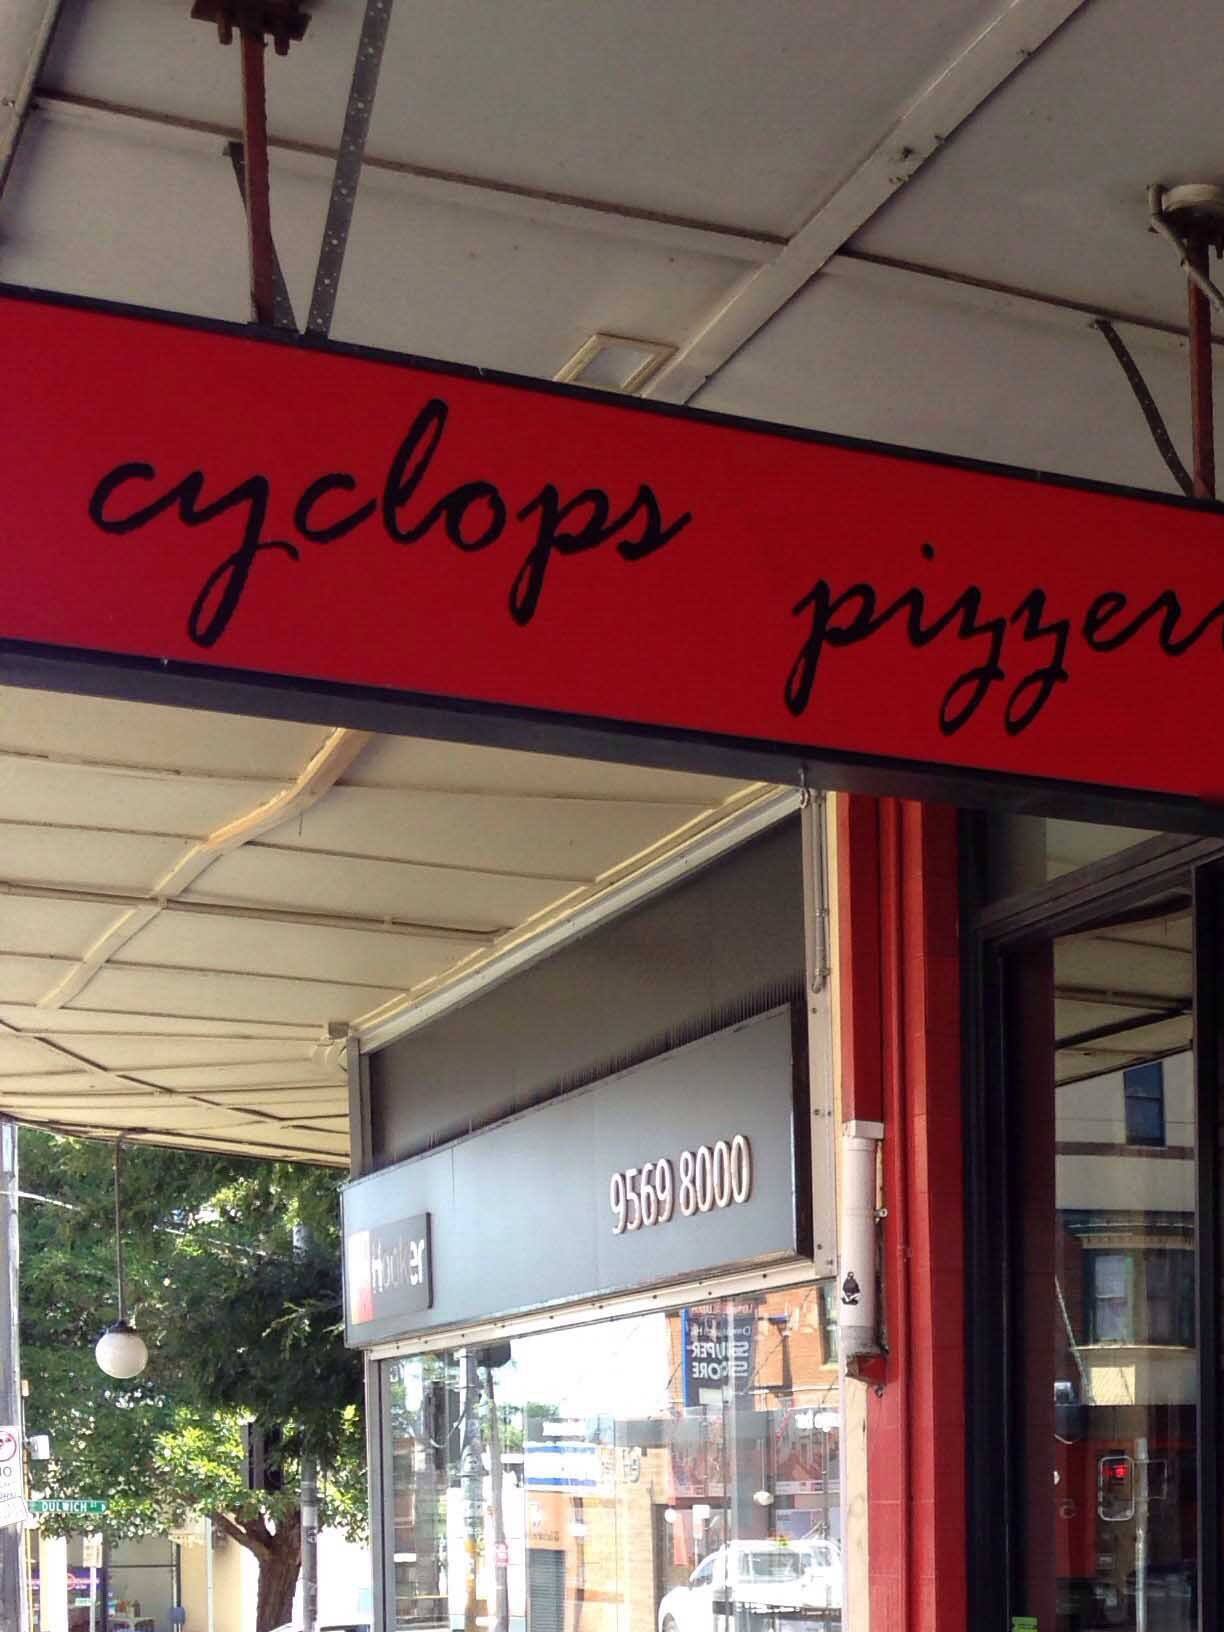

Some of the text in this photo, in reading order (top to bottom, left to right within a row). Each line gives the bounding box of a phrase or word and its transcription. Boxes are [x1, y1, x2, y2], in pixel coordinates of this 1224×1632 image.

[88, 398, 692, 647] cyclops
[609, 1134, 751, 1235] 9569 8000
[41, 1501, 87, 1512] DULWICH
